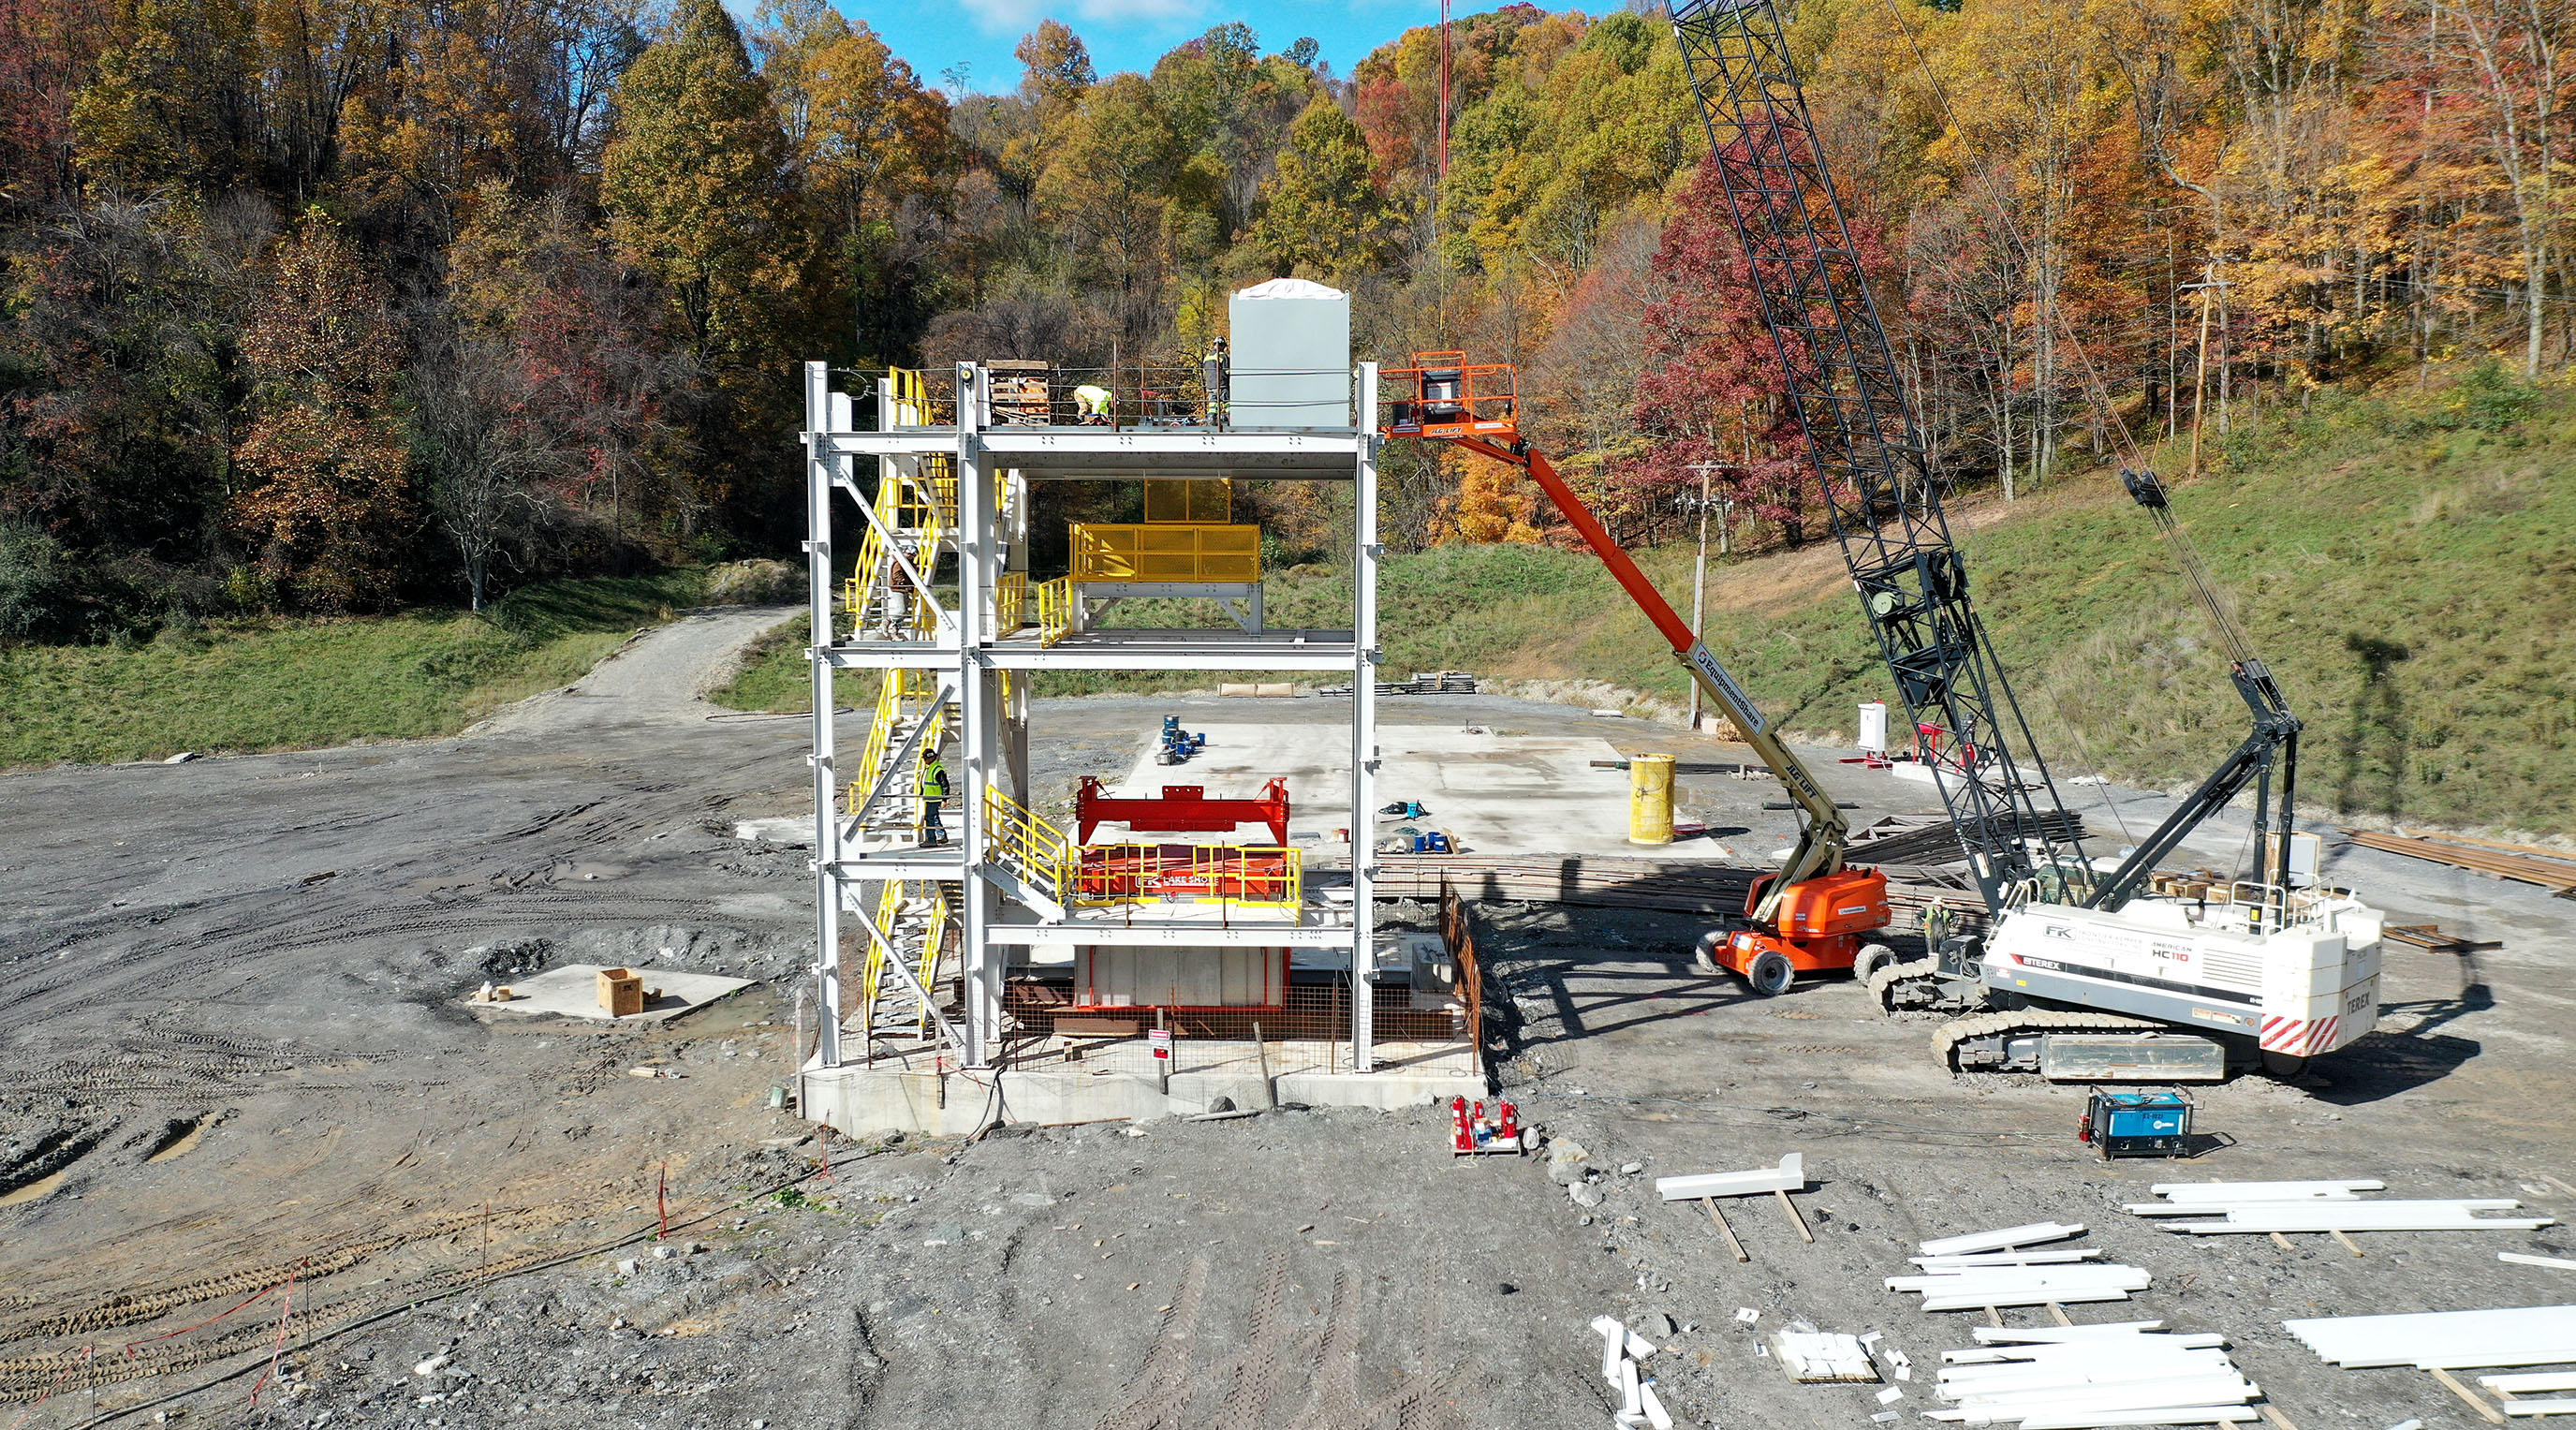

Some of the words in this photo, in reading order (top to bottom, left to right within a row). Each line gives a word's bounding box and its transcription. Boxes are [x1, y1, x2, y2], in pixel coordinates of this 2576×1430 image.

[1705, 659, 1759, 728] EquipmentShare
[1786, 764, 1800, 781] JLG
[1799, 779, 1818, 799] LIFT
[2151, 942, 2193, 952] AMERICAN
[2030, 958, 2061, 971] TEREX
[2347, 992, 2371, 1016] TEREX
